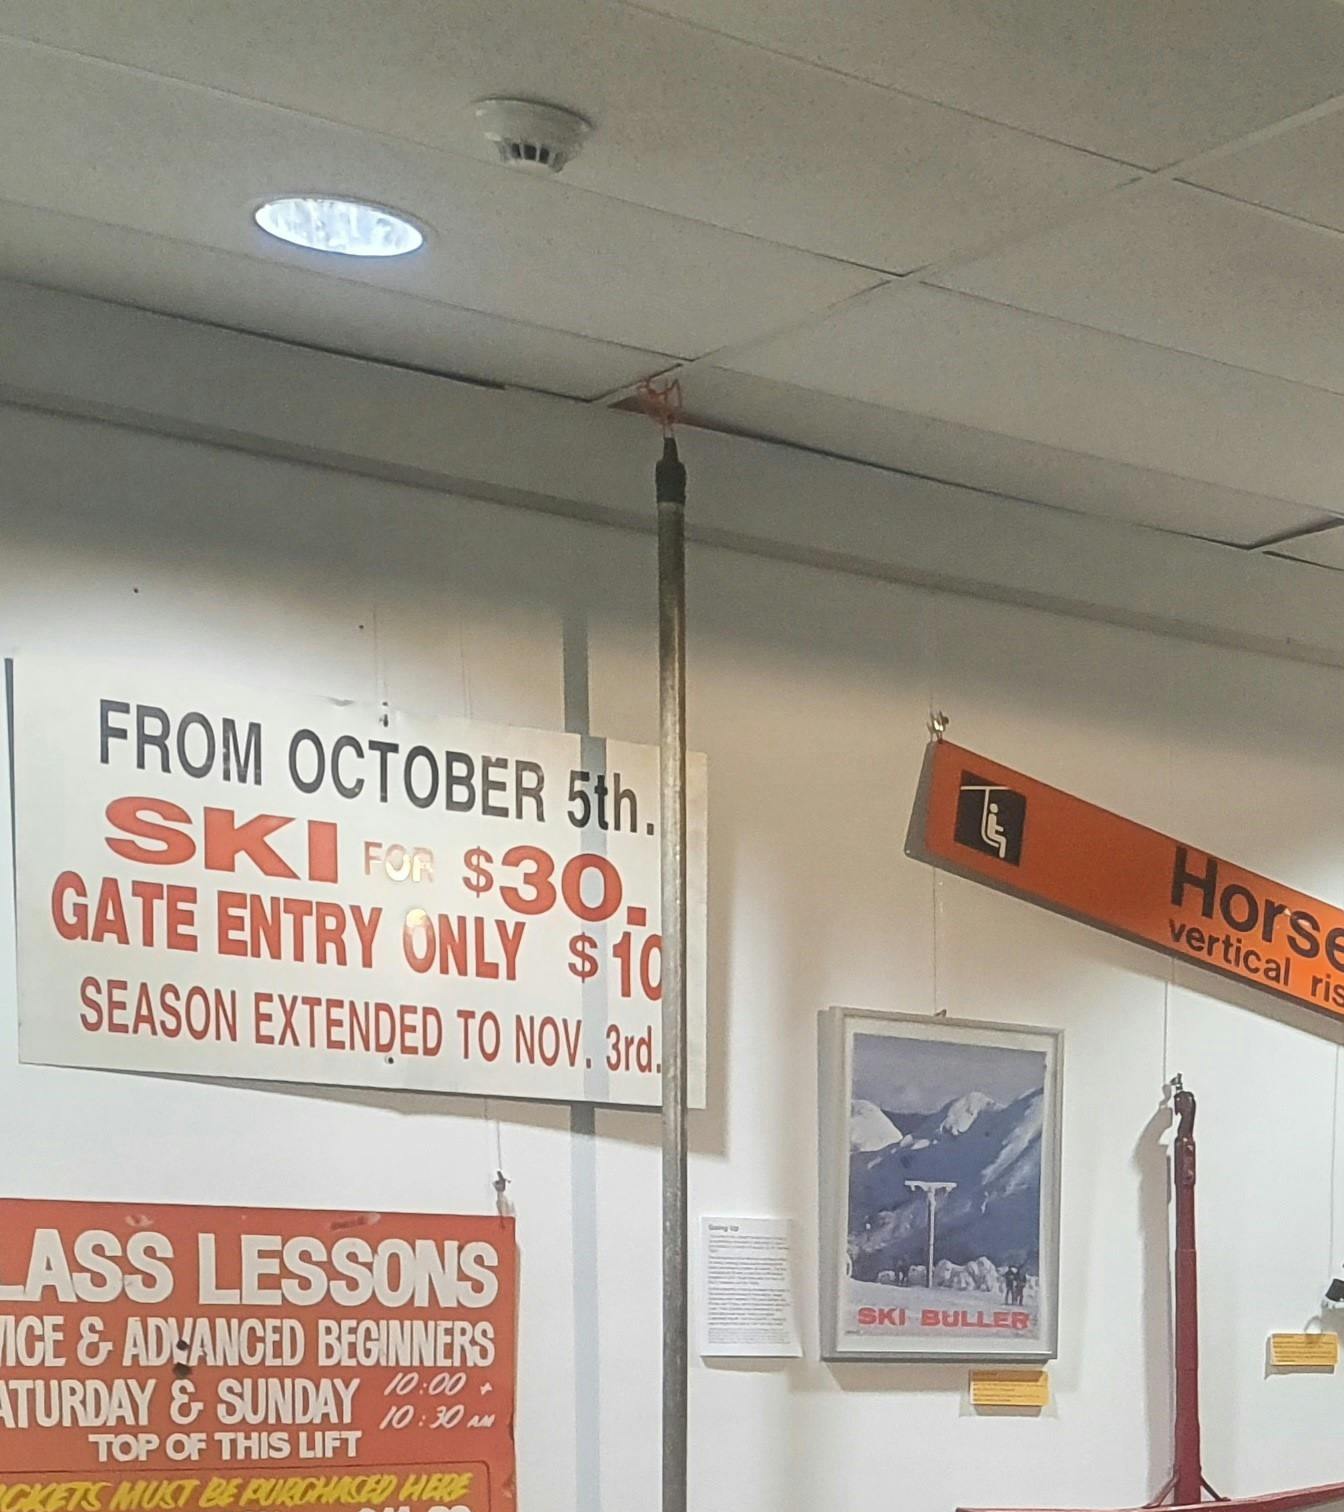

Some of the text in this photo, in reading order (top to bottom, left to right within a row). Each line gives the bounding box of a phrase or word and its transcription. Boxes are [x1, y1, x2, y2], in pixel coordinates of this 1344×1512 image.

[99, 698, 655, 836] FROM OCTOBER 5th.
[104, 795, 647, 927] SKI FOR $30.
[51, 870, 199, 953] GATE
[216, 889, 384, 970] ENTRY
[403, 907, 526, 981] ONLY
[1168, 918, 1289, 987] vertical
[80, 976, 662, 1074] SEASON EXTENDED TO NOV. 3rd.
[199, 1233, 499, 1308] LESSONS
[77, 1316, 113, 1366] &
[122, 1316, 304, 1367] ADVANCED
[318, 1319, 495, 1367] BEGINNERS
[858, 1307, 1029, 1329] SKI BULLER
[170, 1378, 204, 1425] &
[217, 1378, 360, 1425] SUNDAY
[88, 1430, 362, 1462] TOP OF THIS LIFT
[110, 1478, 200, 1510] MUST
[199, 1477, 243, 1508] BE
[241, 1474, 397, 1506] PURCHASED
[398, 1472, 473, 1502] HERE
